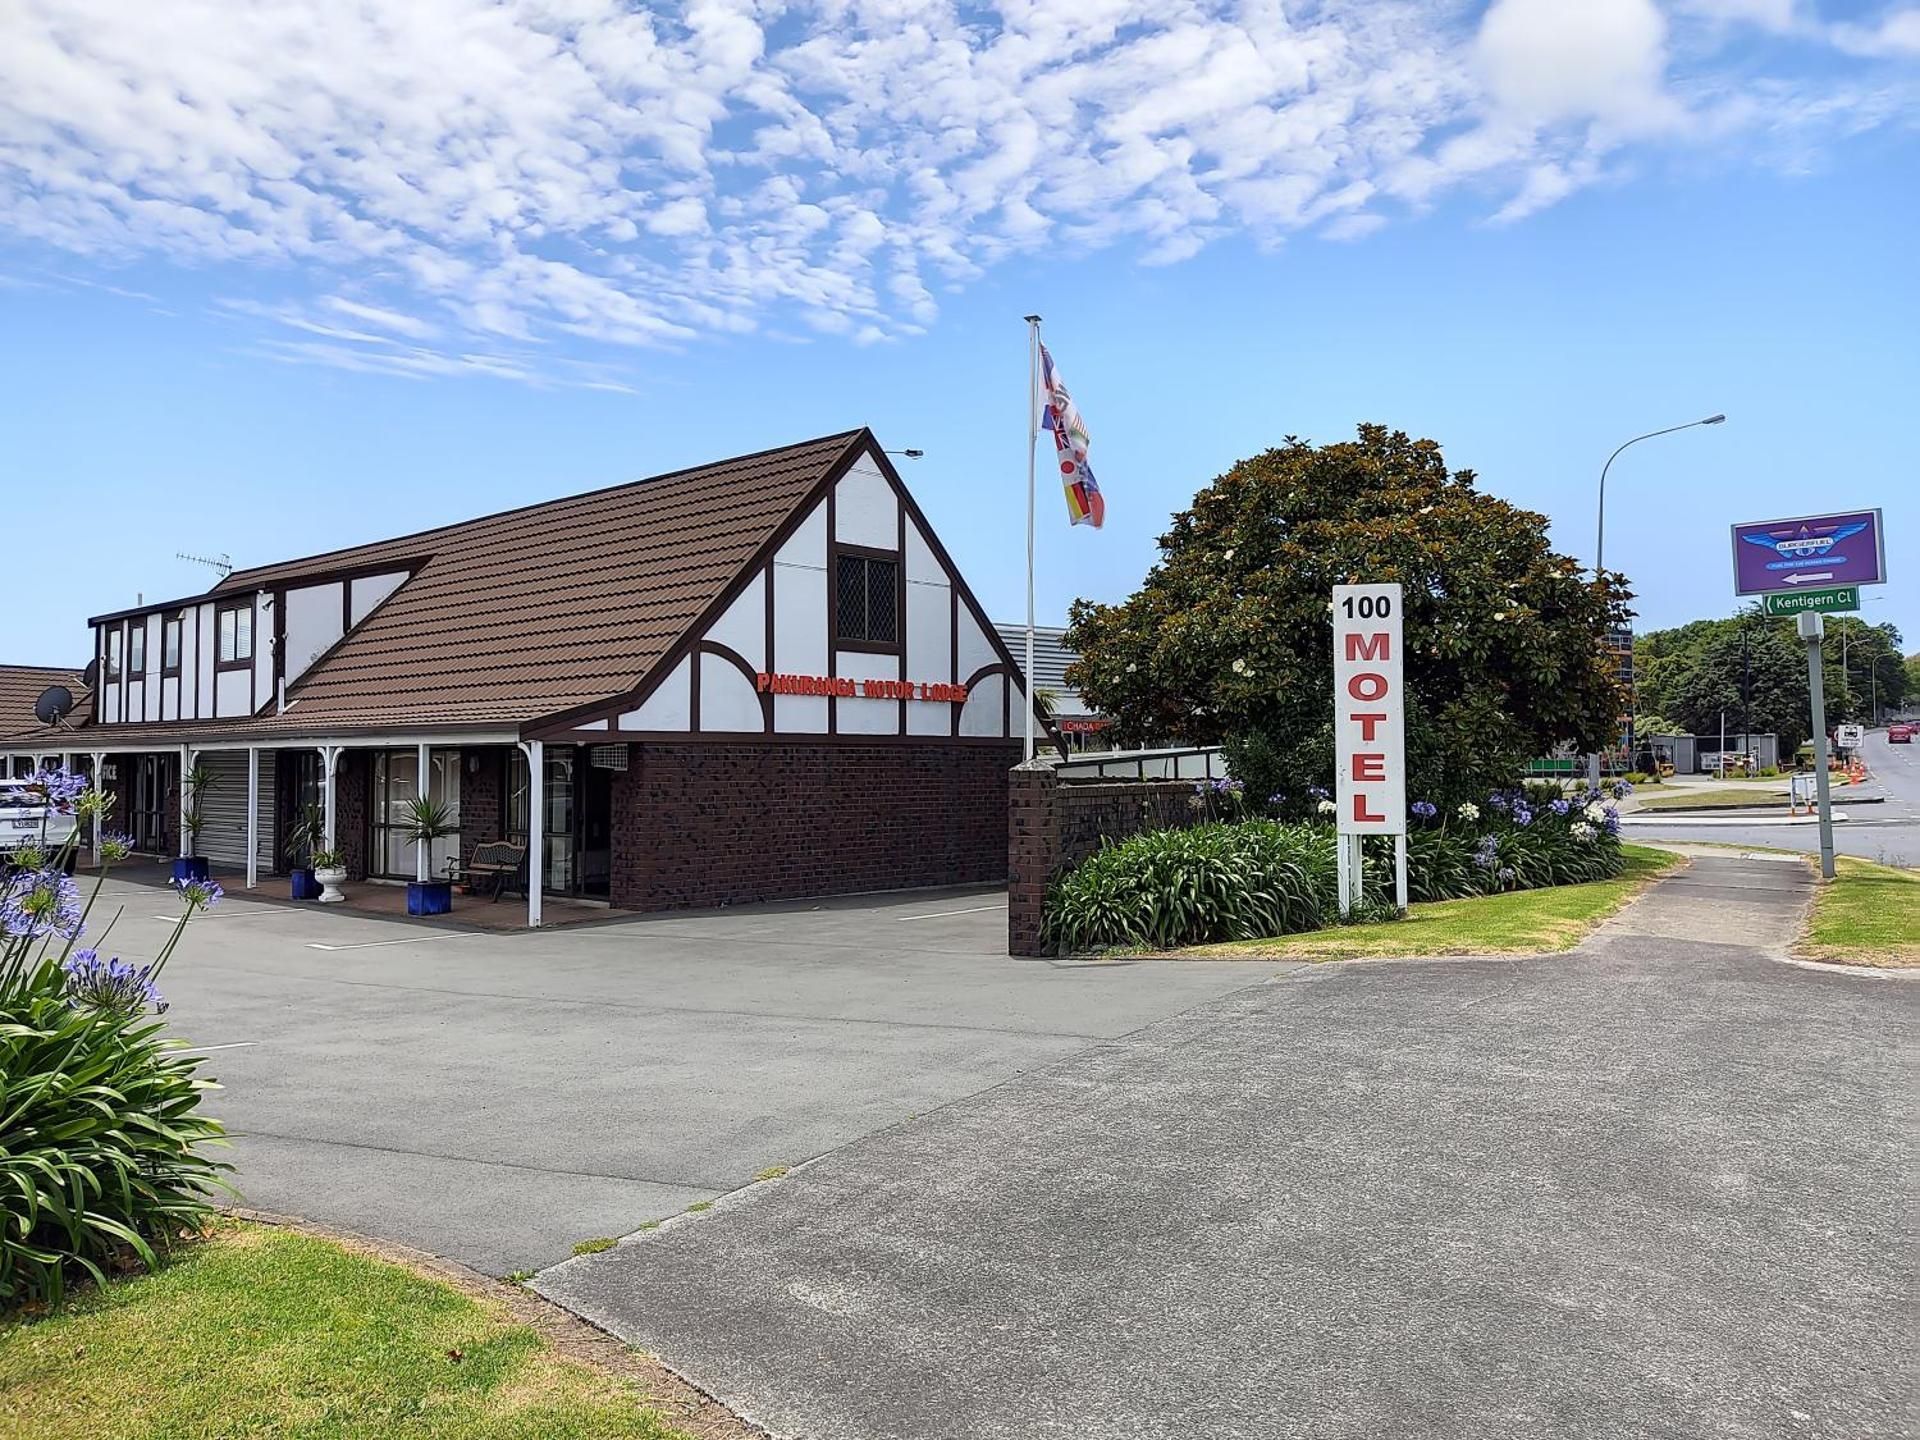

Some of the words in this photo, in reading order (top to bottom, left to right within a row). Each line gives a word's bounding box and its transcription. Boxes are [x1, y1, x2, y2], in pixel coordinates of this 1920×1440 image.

[1342, 596, 1391, 619] 100
[1776, 595, 1833, 609] Kentigern
[1837, 591, 1852, 603] Cl
[757, 672, 857, 697] PAKURANGA
[864, 679, 914, 699] MOTOR
[921, 683, 968, 703] LODGE
[1345, 633, 1390, 822] MOTEL
